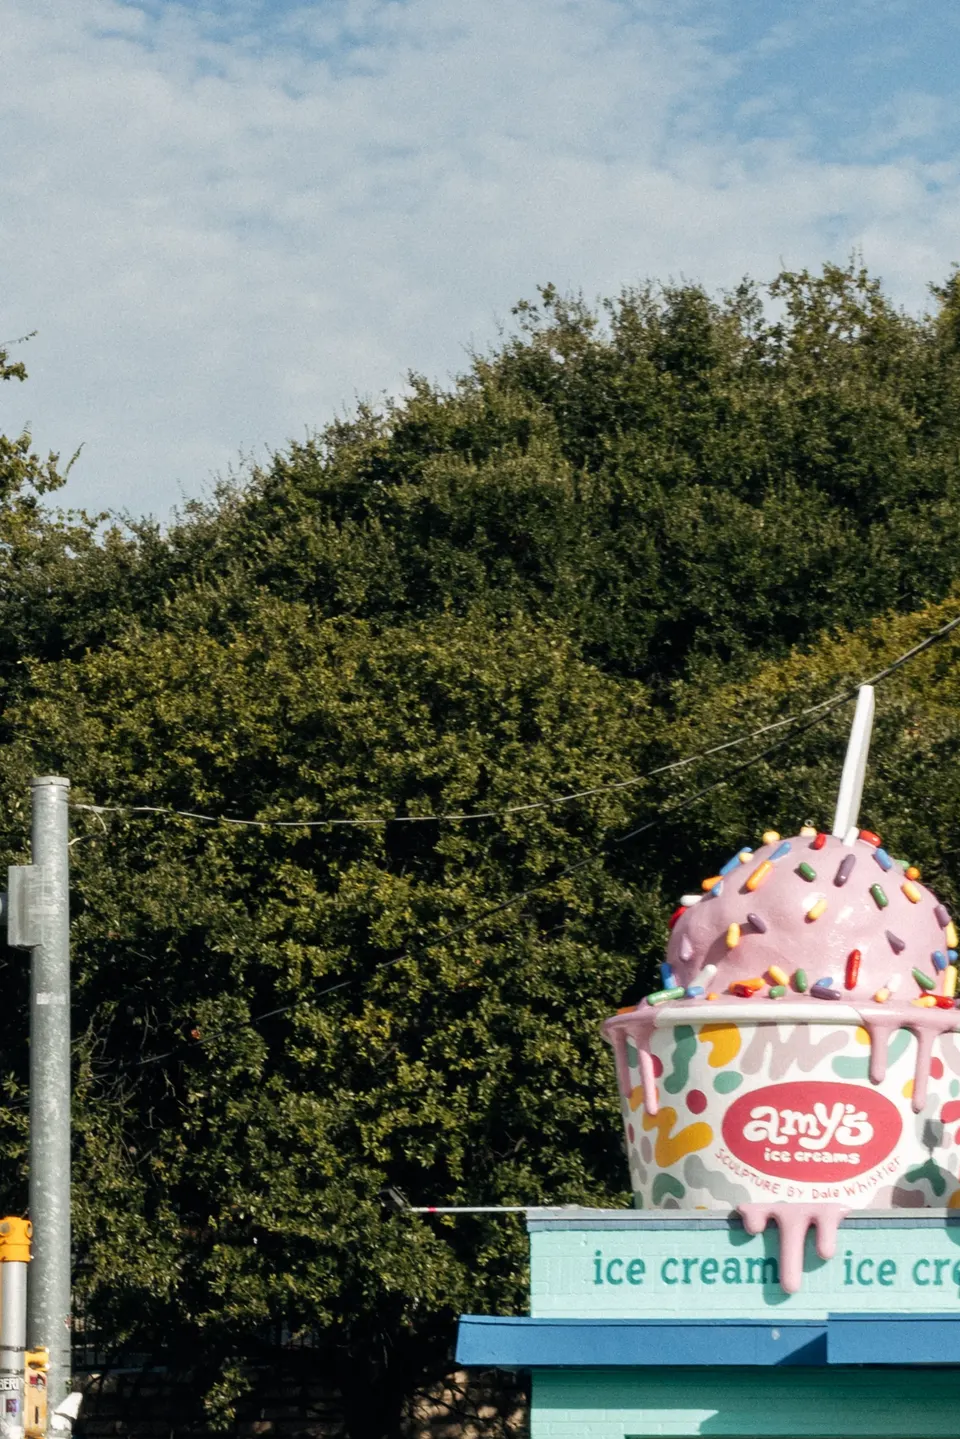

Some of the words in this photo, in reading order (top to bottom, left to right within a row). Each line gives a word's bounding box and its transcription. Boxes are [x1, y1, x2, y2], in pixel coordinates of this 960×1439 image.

[742, 1102, 875, 1150] amy's
[714, 1147, 780, 1195] SCULPTURE
[785, 1184, 805, 1198] BY
[811, 1186, 840, 1200] Dale
[763, 1147, 792, 1163] ice
[794, 1150, 861, 1165] creams
[593, 1249, 646, 1285] ice
[660, 1256, 781, 1285] cream
[843, 1249, 897, 1286] ice
